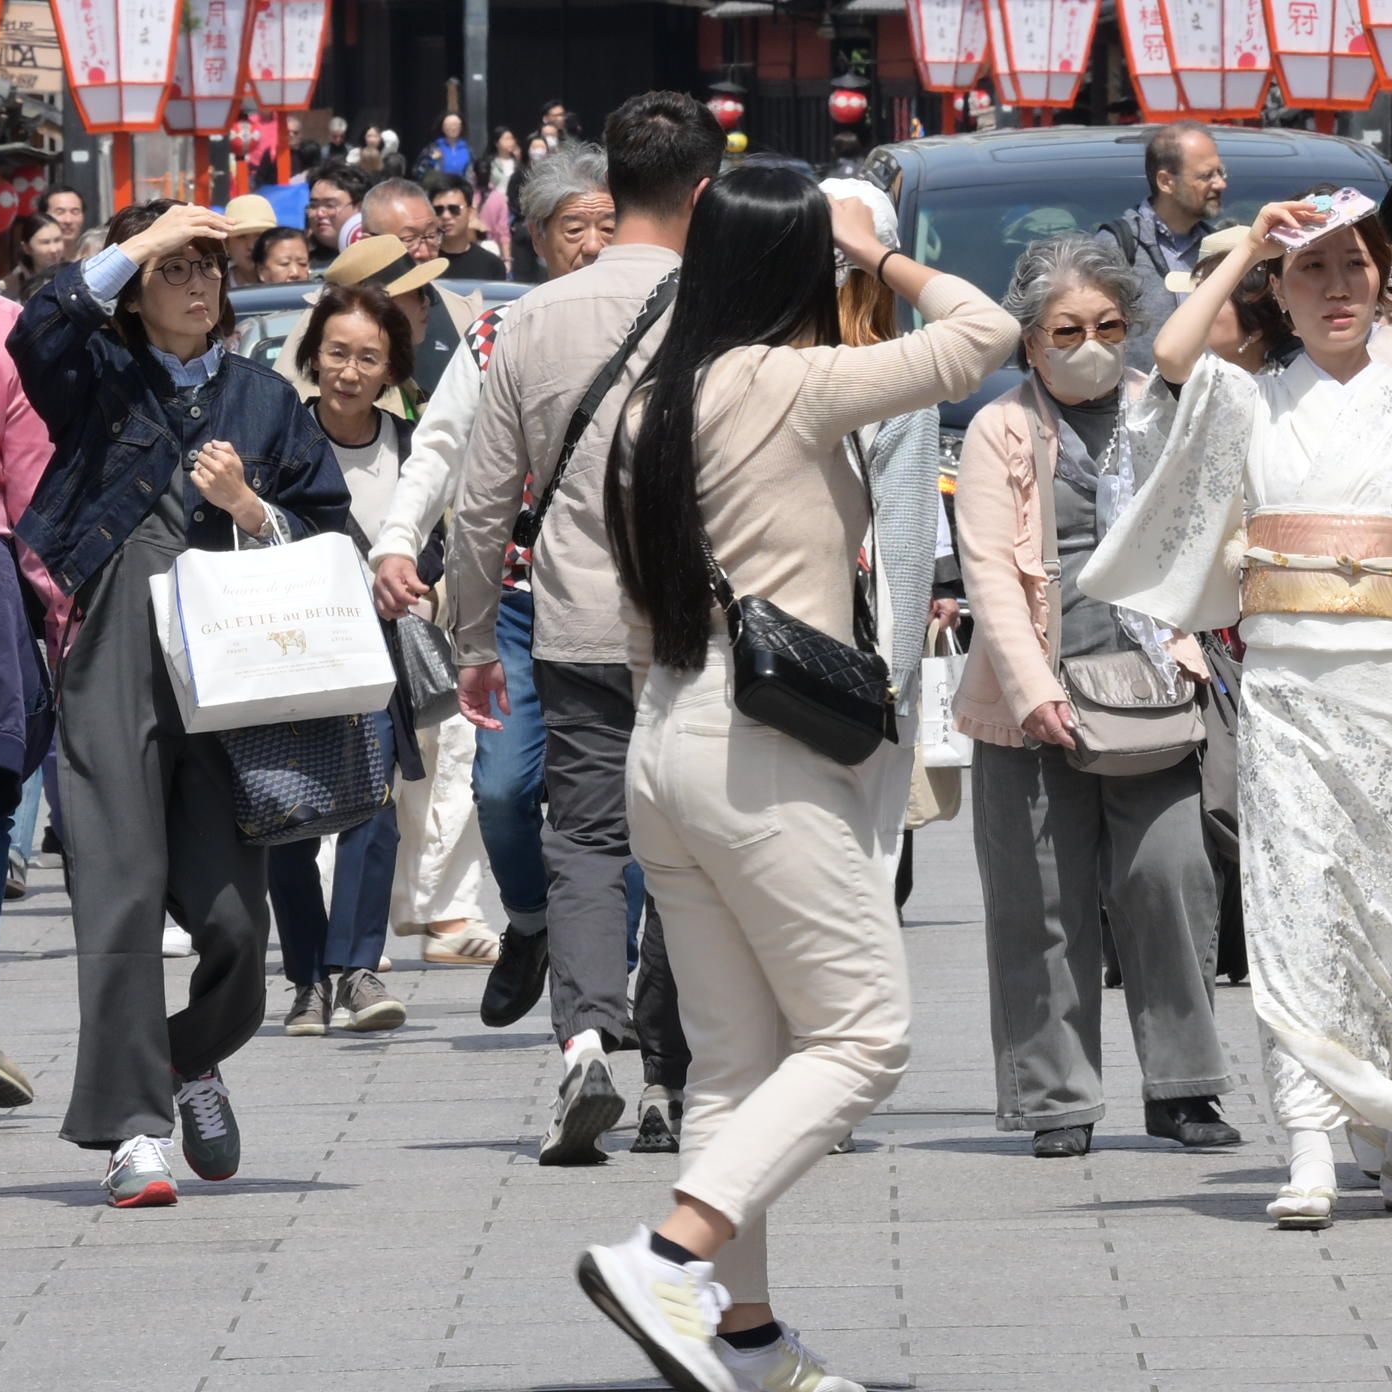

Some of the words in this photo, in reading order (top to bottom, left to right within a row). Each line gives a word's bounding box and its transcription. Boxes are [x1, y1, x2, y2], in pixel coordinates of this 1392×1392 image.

[201, 612, 278, 636] GALETTE
[282, 612, 300, 622] au
[305, 607, 363, 621] BEURRE
